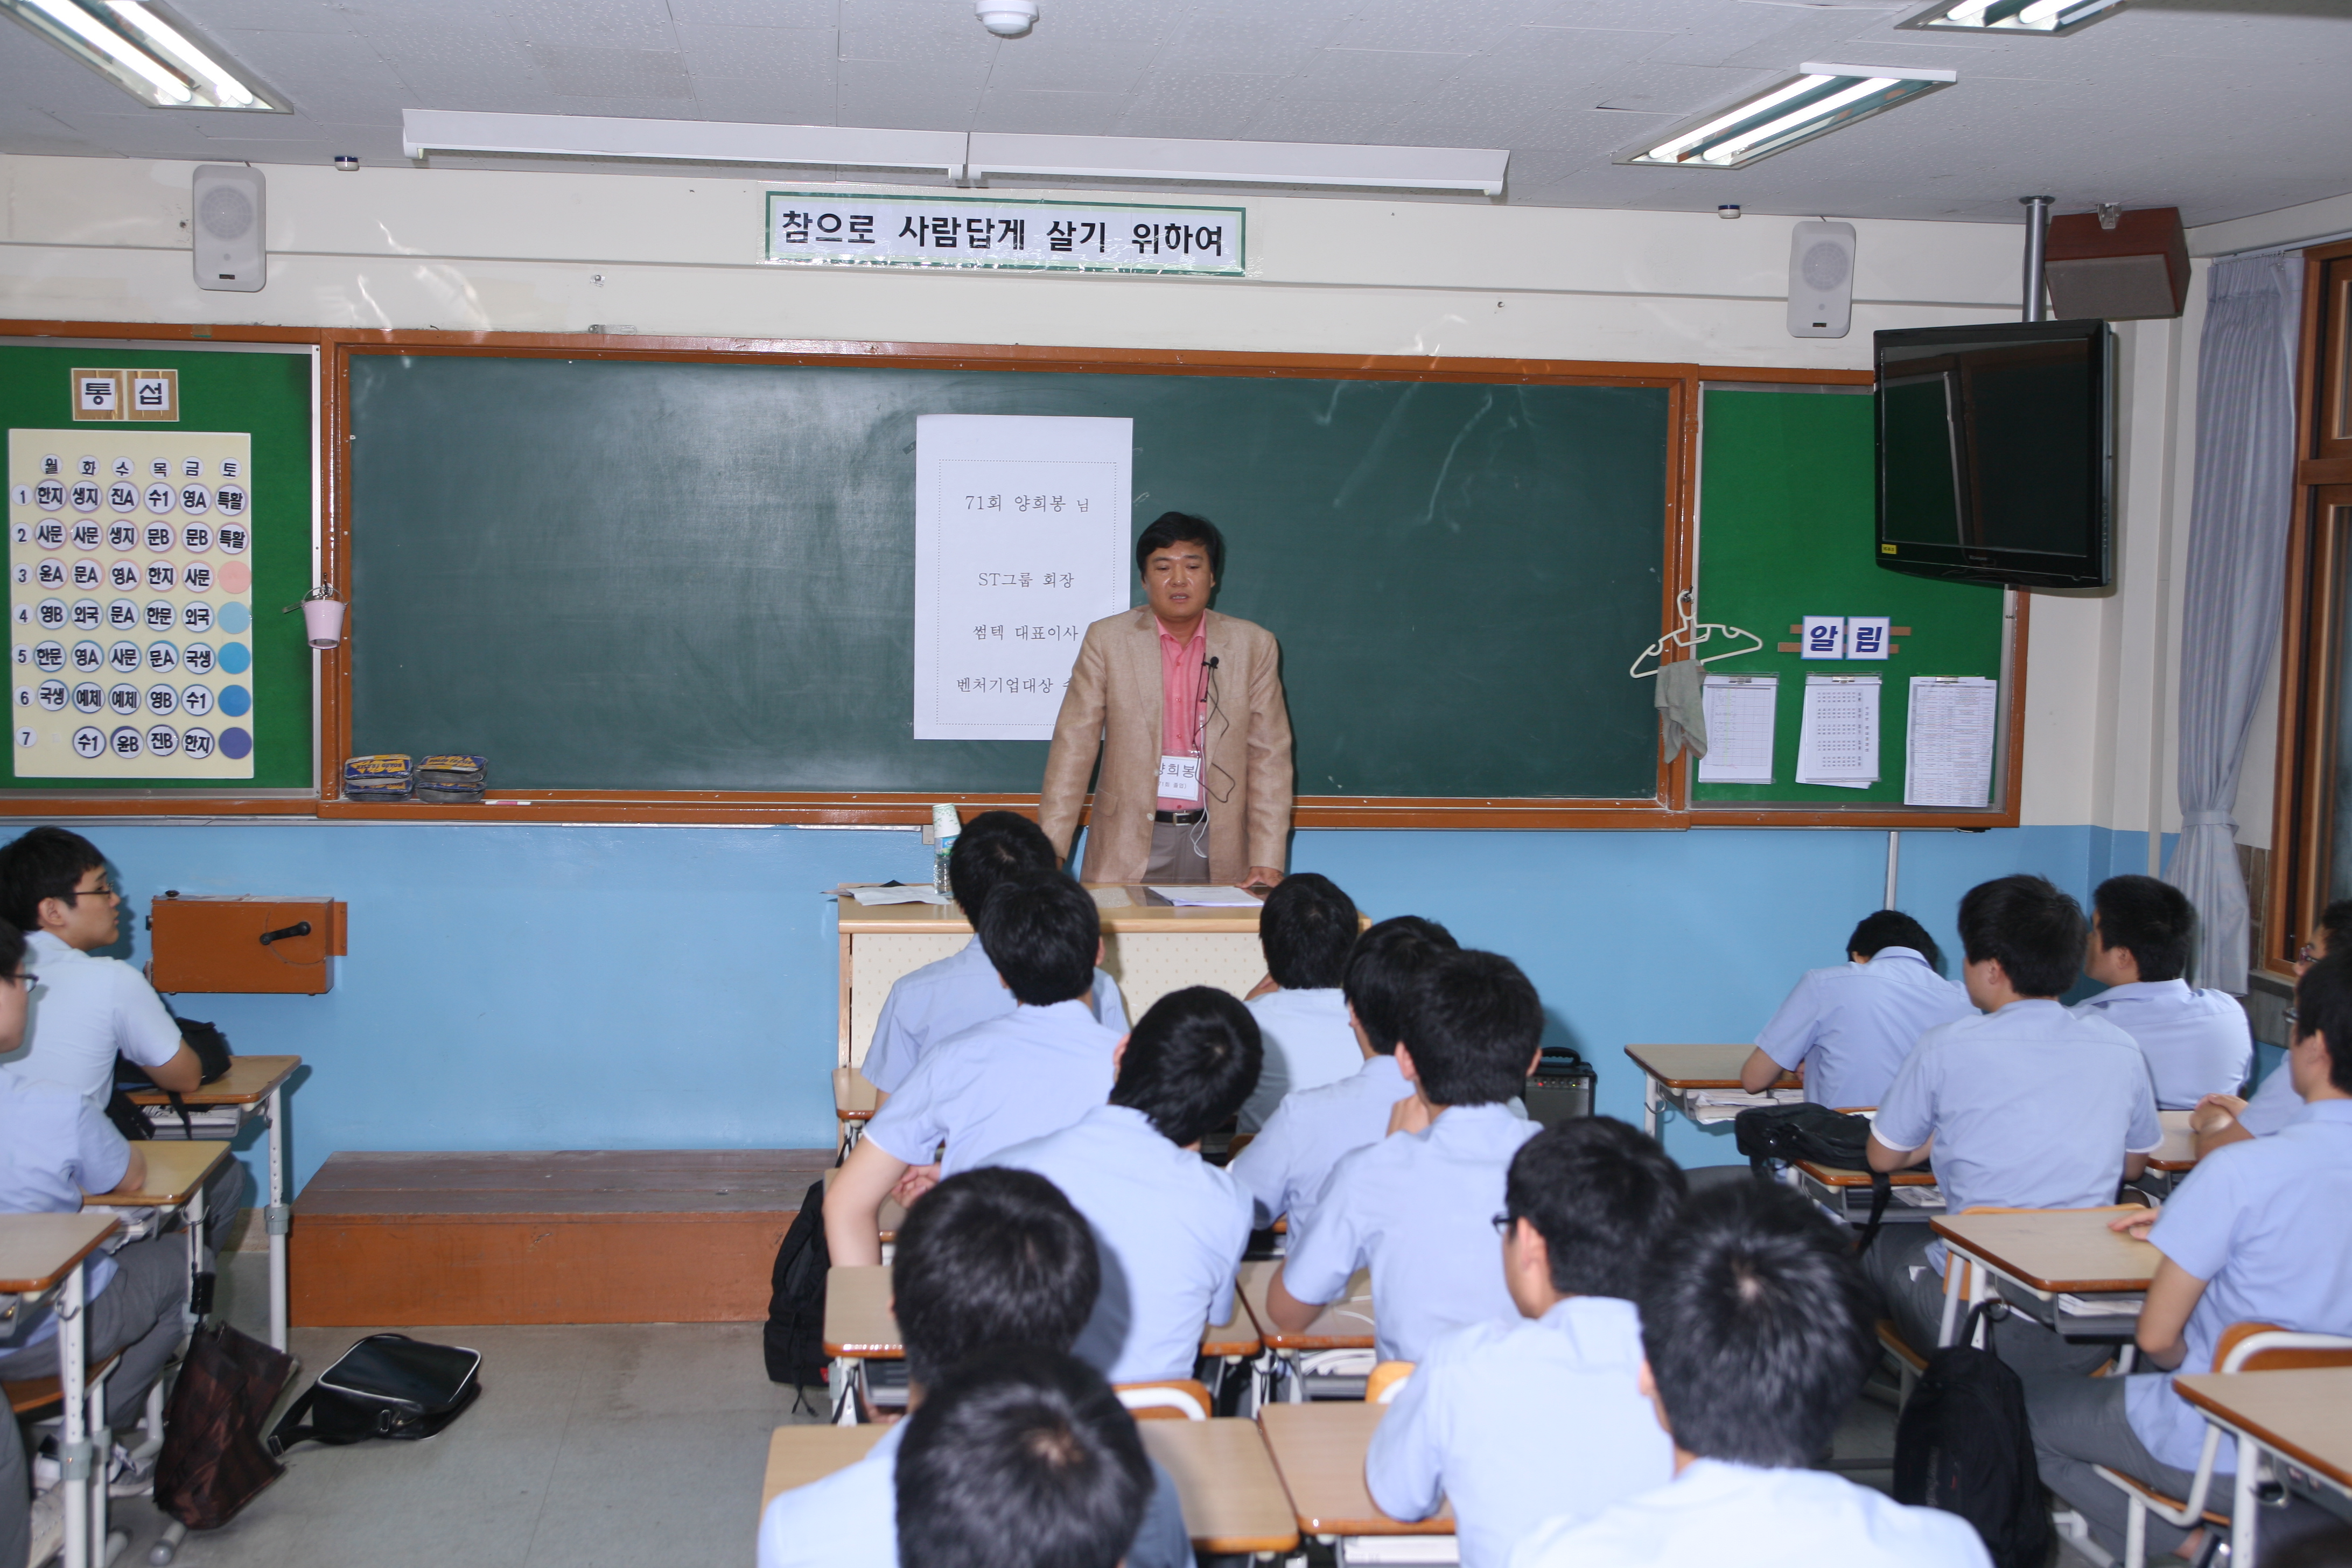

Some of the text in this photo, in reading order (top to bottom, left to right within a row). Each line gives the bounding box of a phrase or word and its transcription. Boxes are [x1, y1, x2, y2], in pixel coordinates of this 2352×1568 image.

[782, 211, 1222, 256] 참으로 사람답게 살기 위하여
[85, 382, 163, 406] 통섭
[45, 458, 236, 477] 월 화 수 목 금 토
[20, 487, 243, 510] 1 한지 생지 진A 수1 영A 특활
[965, 494, 1088, 513] 71회 양희봉 님
[17, 525, 246, 549] 2 사문 사문 생지 문B 문B 특활
[18, 565, 210, 586] 3 윤A 문A 영A 한지 사문
[978, 572, 1074, 589] ST그룹 회장
[19, 605, 210, 626] 4 영B 외국 문A 한문 외국
[973, 624, 1079, 641] 썸텍 대표이사
[1810, 625, 1882, 653] 알림
[18, 648, 211, 668] 5 한문 영A 사문 문A 국생
[957, 677, 1054, 694] 벤처기업대상
[20, 687, 206, 709] 6 국생 예체 예체 영B 수1
[22, 732, 211, 754] 7 수1 윤B 진B 한지
